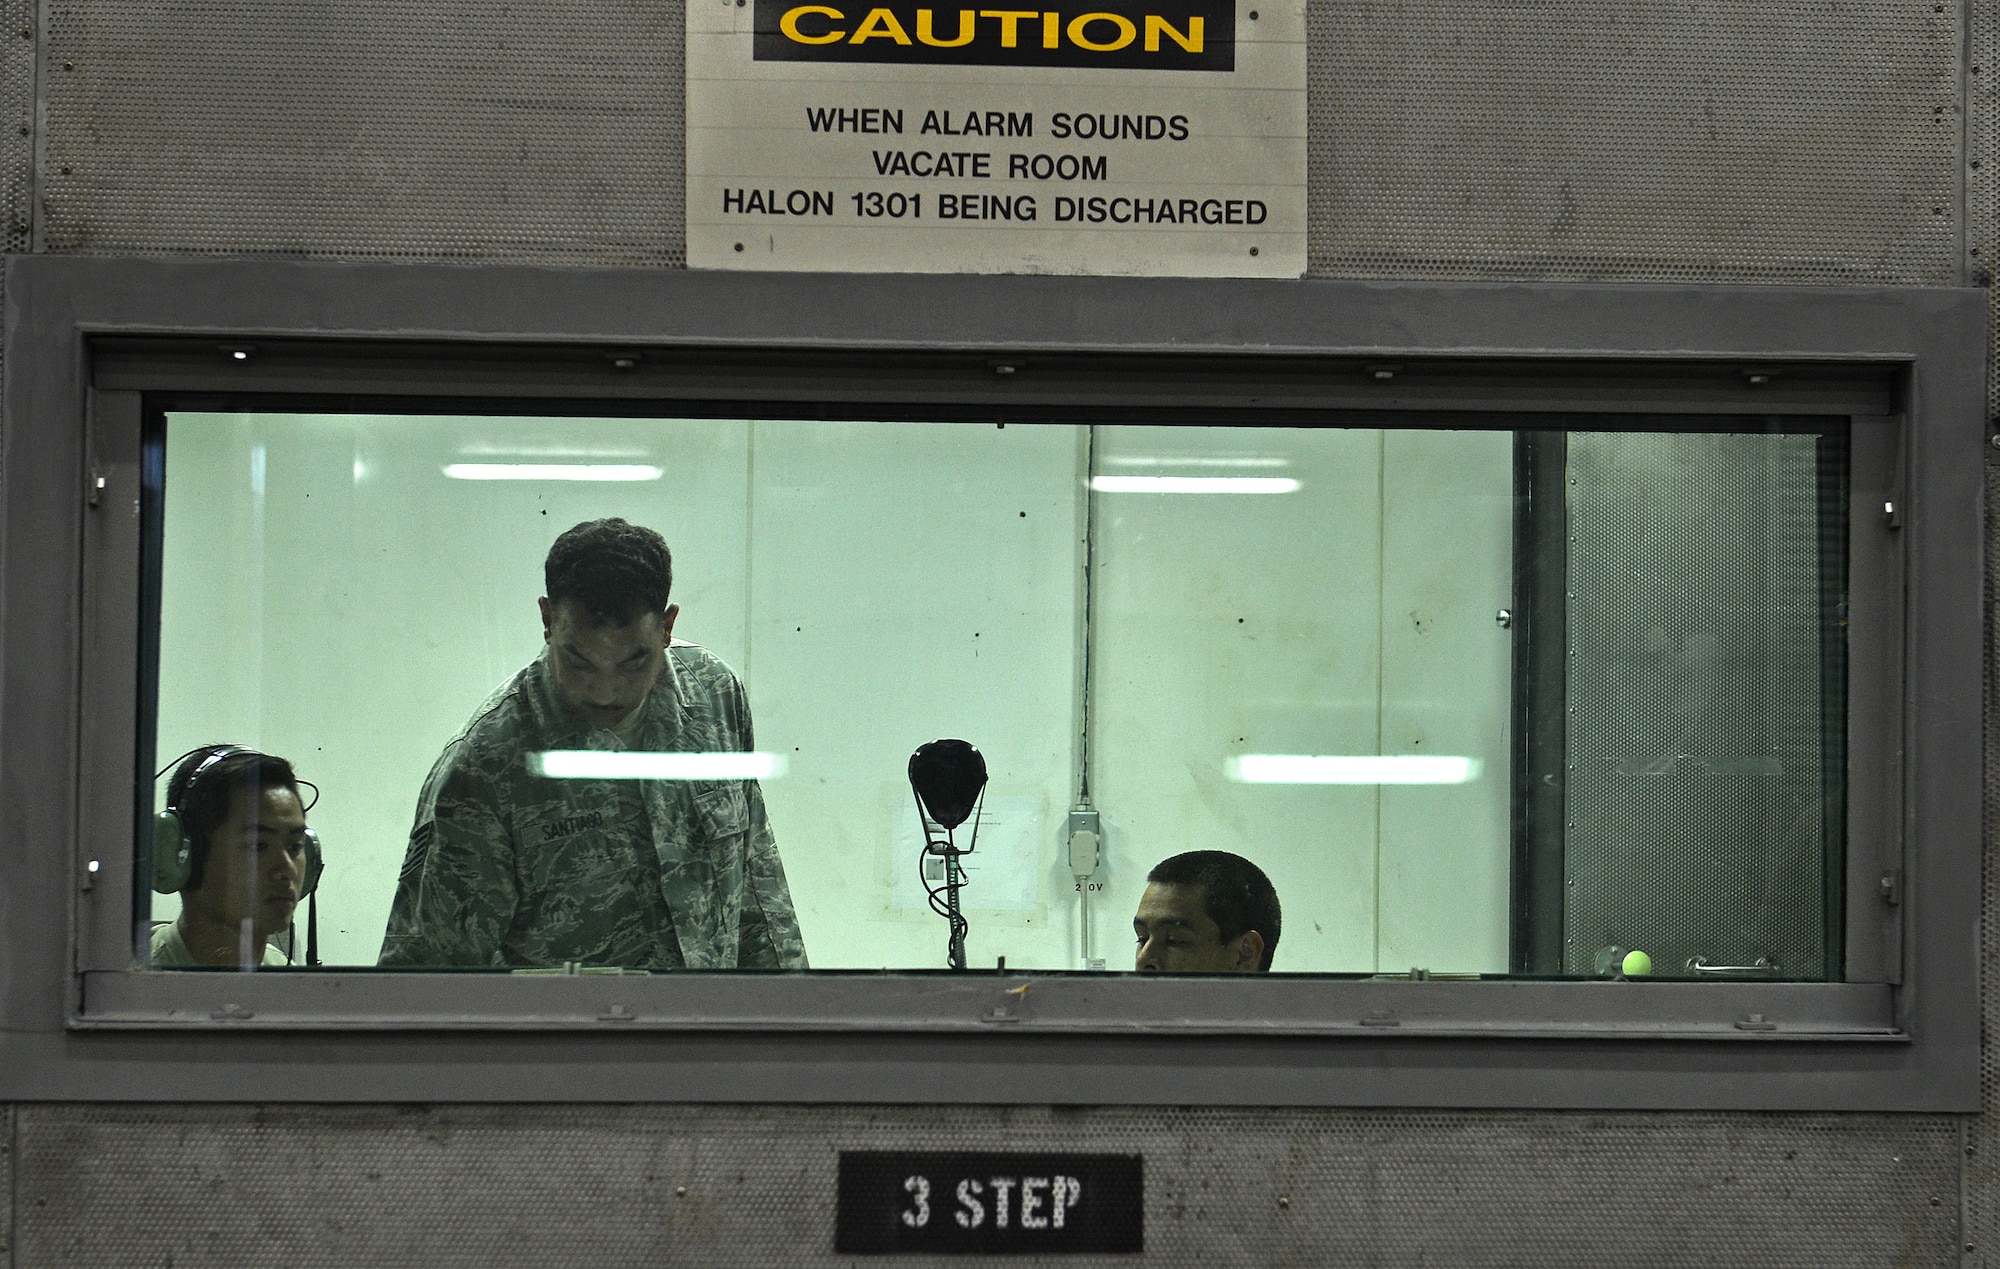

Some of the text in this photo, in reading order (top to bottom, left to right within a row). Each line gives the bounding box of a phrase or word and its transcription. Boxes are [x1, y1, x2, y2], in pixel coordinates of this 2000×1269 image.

[779, 6, 1205, 53] CAUTION
[806, 107, 1190, 141] WHEN ALARM SOUNDS
[872, 151, 1108, 181] VACATE ROOM
[722, 189, 1268, 225] HALON 1301 BEING DISCHARGED
[541, 811, 604, 841] SANTIAGO
[1075, 883, 1104, 892] 20V
[902, 1175, 1081, 1229] 3 STEP
